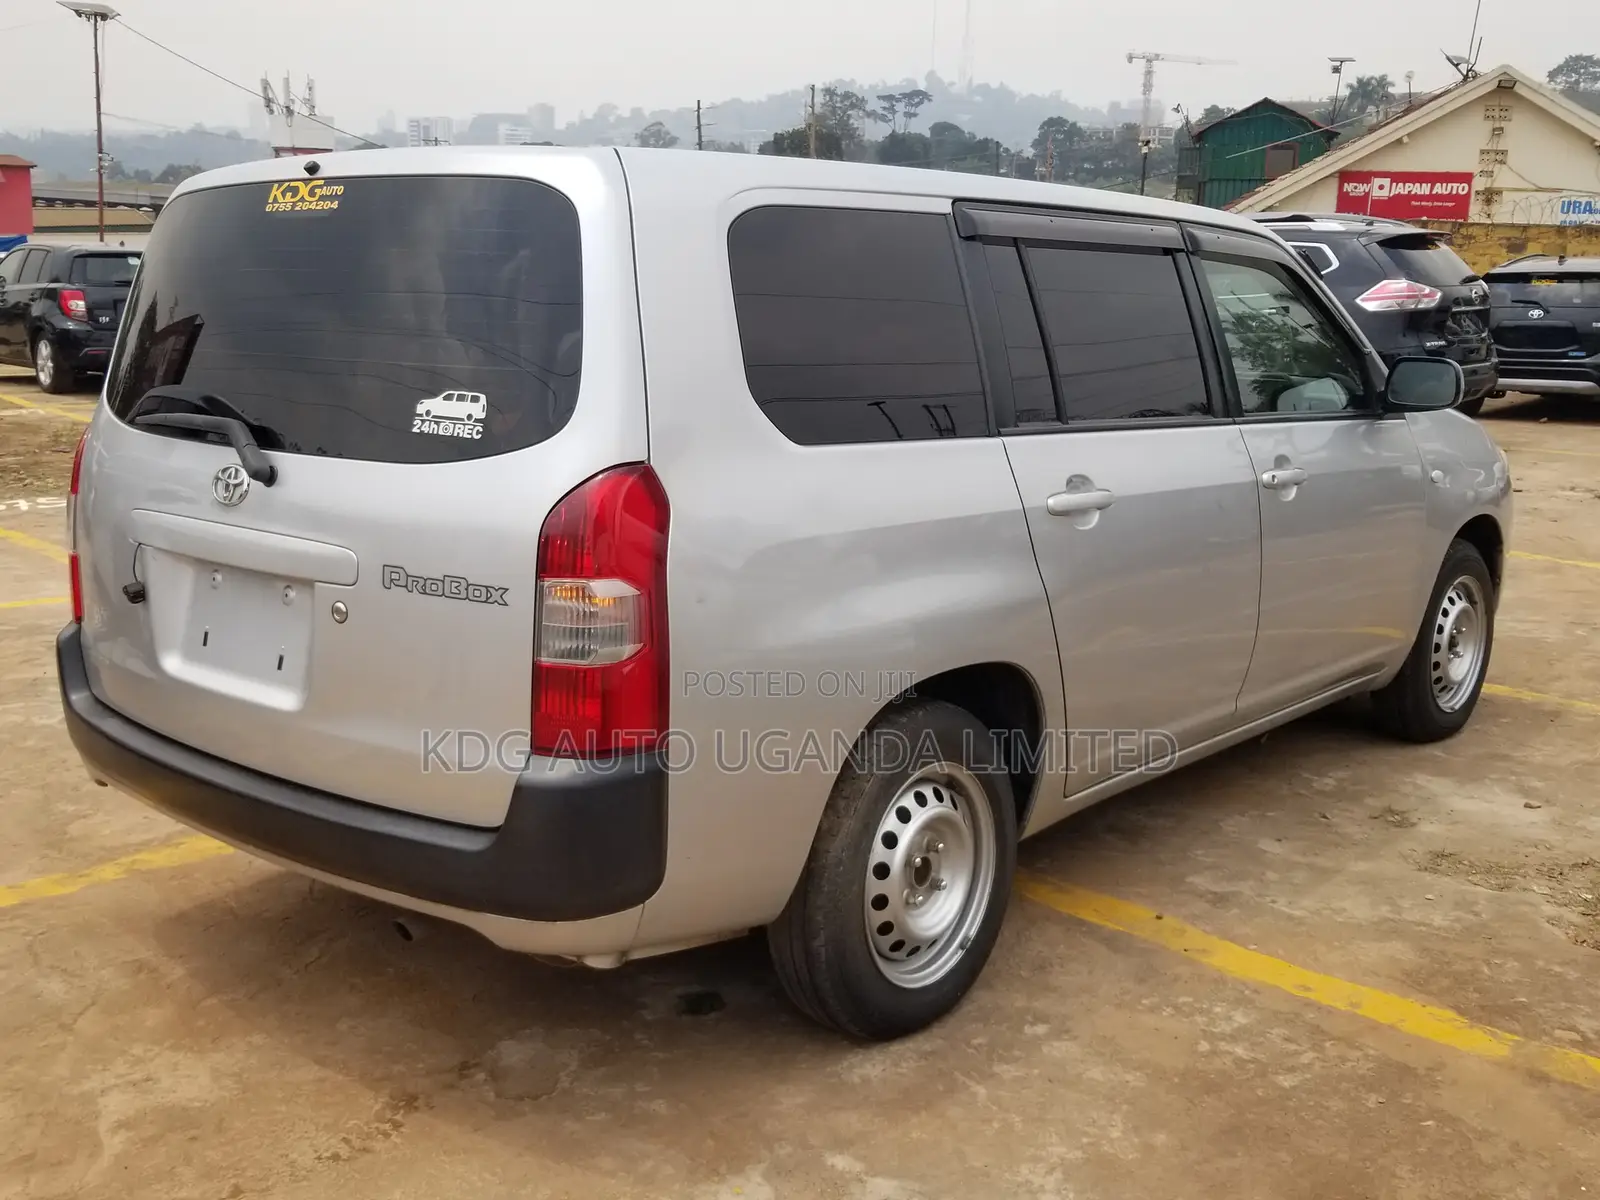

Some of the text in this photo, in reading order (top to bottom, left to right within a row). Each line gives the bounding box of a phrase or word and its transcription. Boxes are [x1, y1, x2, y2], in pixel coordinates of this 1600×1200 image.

[268, 180, 344, 203] KDG AUTO
[1390, 182, 1469, 197] JAPAN AUTO
[265, 200, 339, 212] 0755 204204
[1560, 200, 1593, 214] URA
[412, 420, 483, 440] 24h REC
